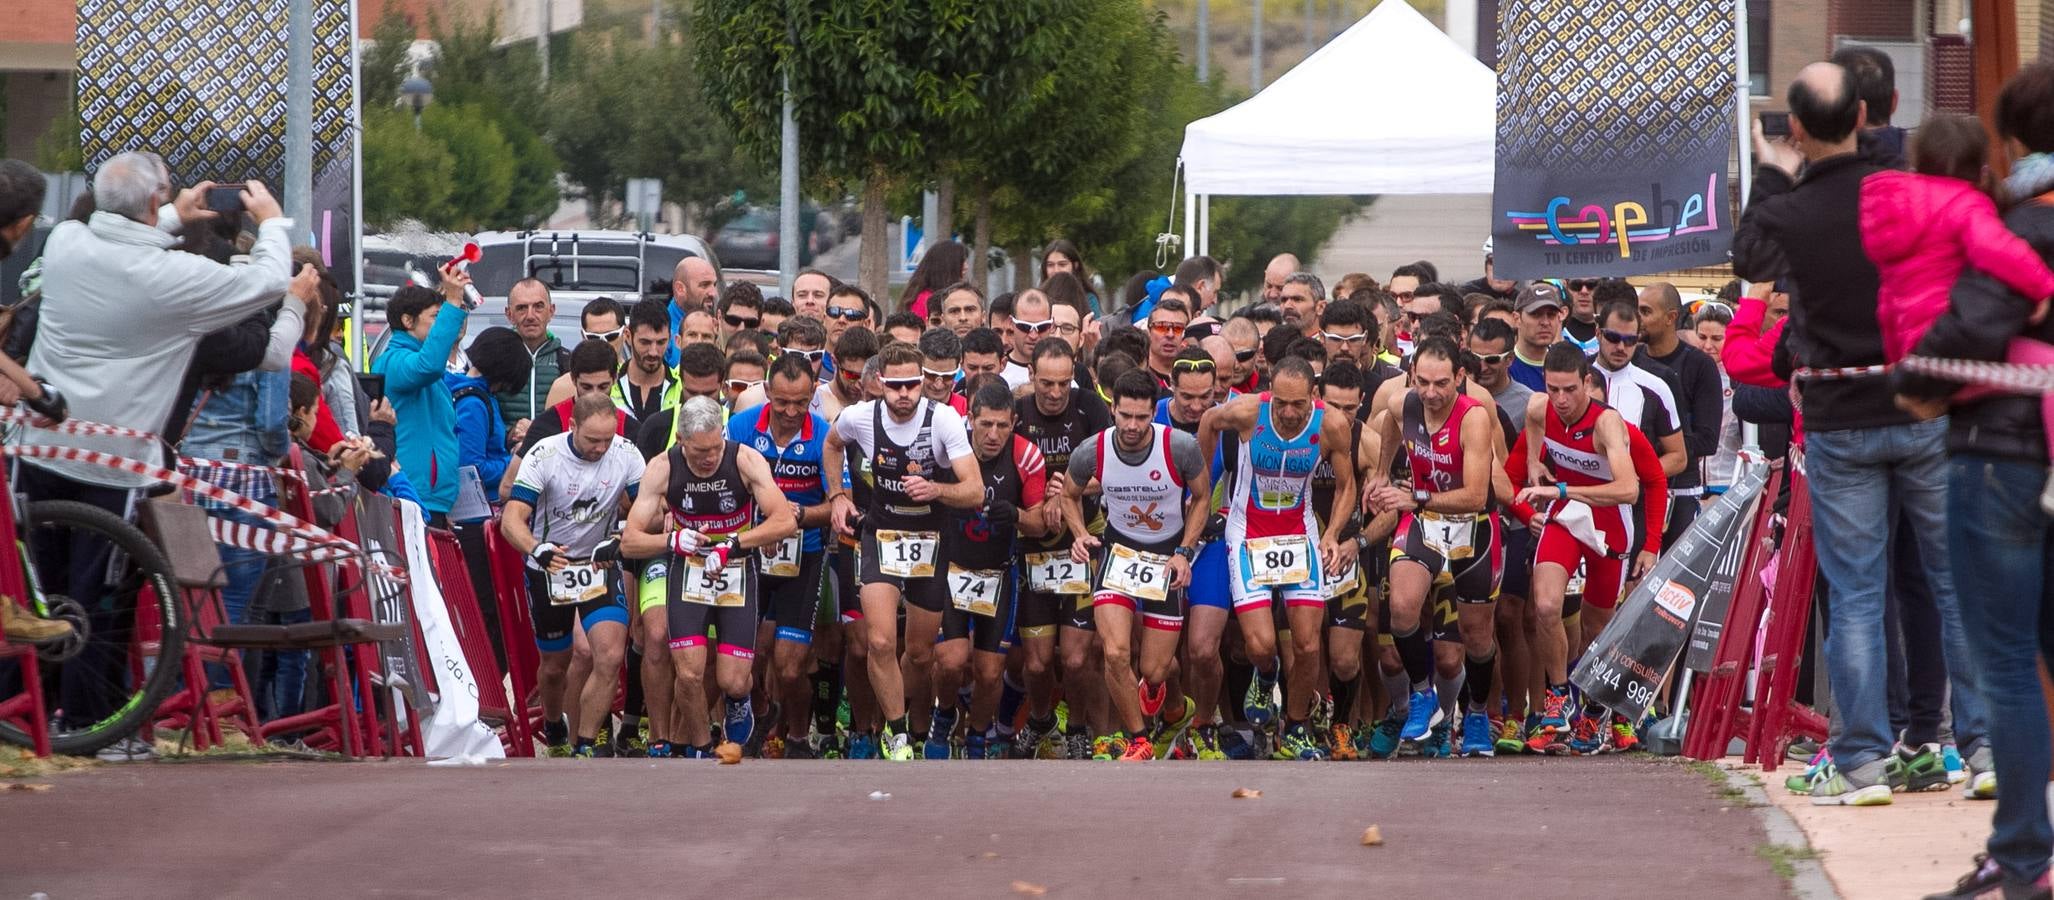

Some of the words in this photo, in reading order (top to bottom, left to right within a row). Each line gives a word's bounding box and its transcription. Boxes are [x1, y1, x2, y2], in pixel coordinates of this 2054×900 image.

[1545, 252, 1561, 265] TU
[1566, 251, 1614, 265] CENTRO
[1632, 249, 1647, 262] DE
[1036, 436, 1071, 454] VILLAR
[1256, 453, 1311, 473] MONAGAS
[683, 480, 728, 493] JIMENEZ
[1442, 526, 1453, 545] 1
[895, 542, 922, 562] 18
[1265, 549, 1295, 569] 80
[562, 568, 592, 589] 30
[700, 570, 729, 592] 55
[1045, 563, 1073, 581] 12
[1123, 562, 1154, 584] 46
[959, 575, 985, 598] 74
